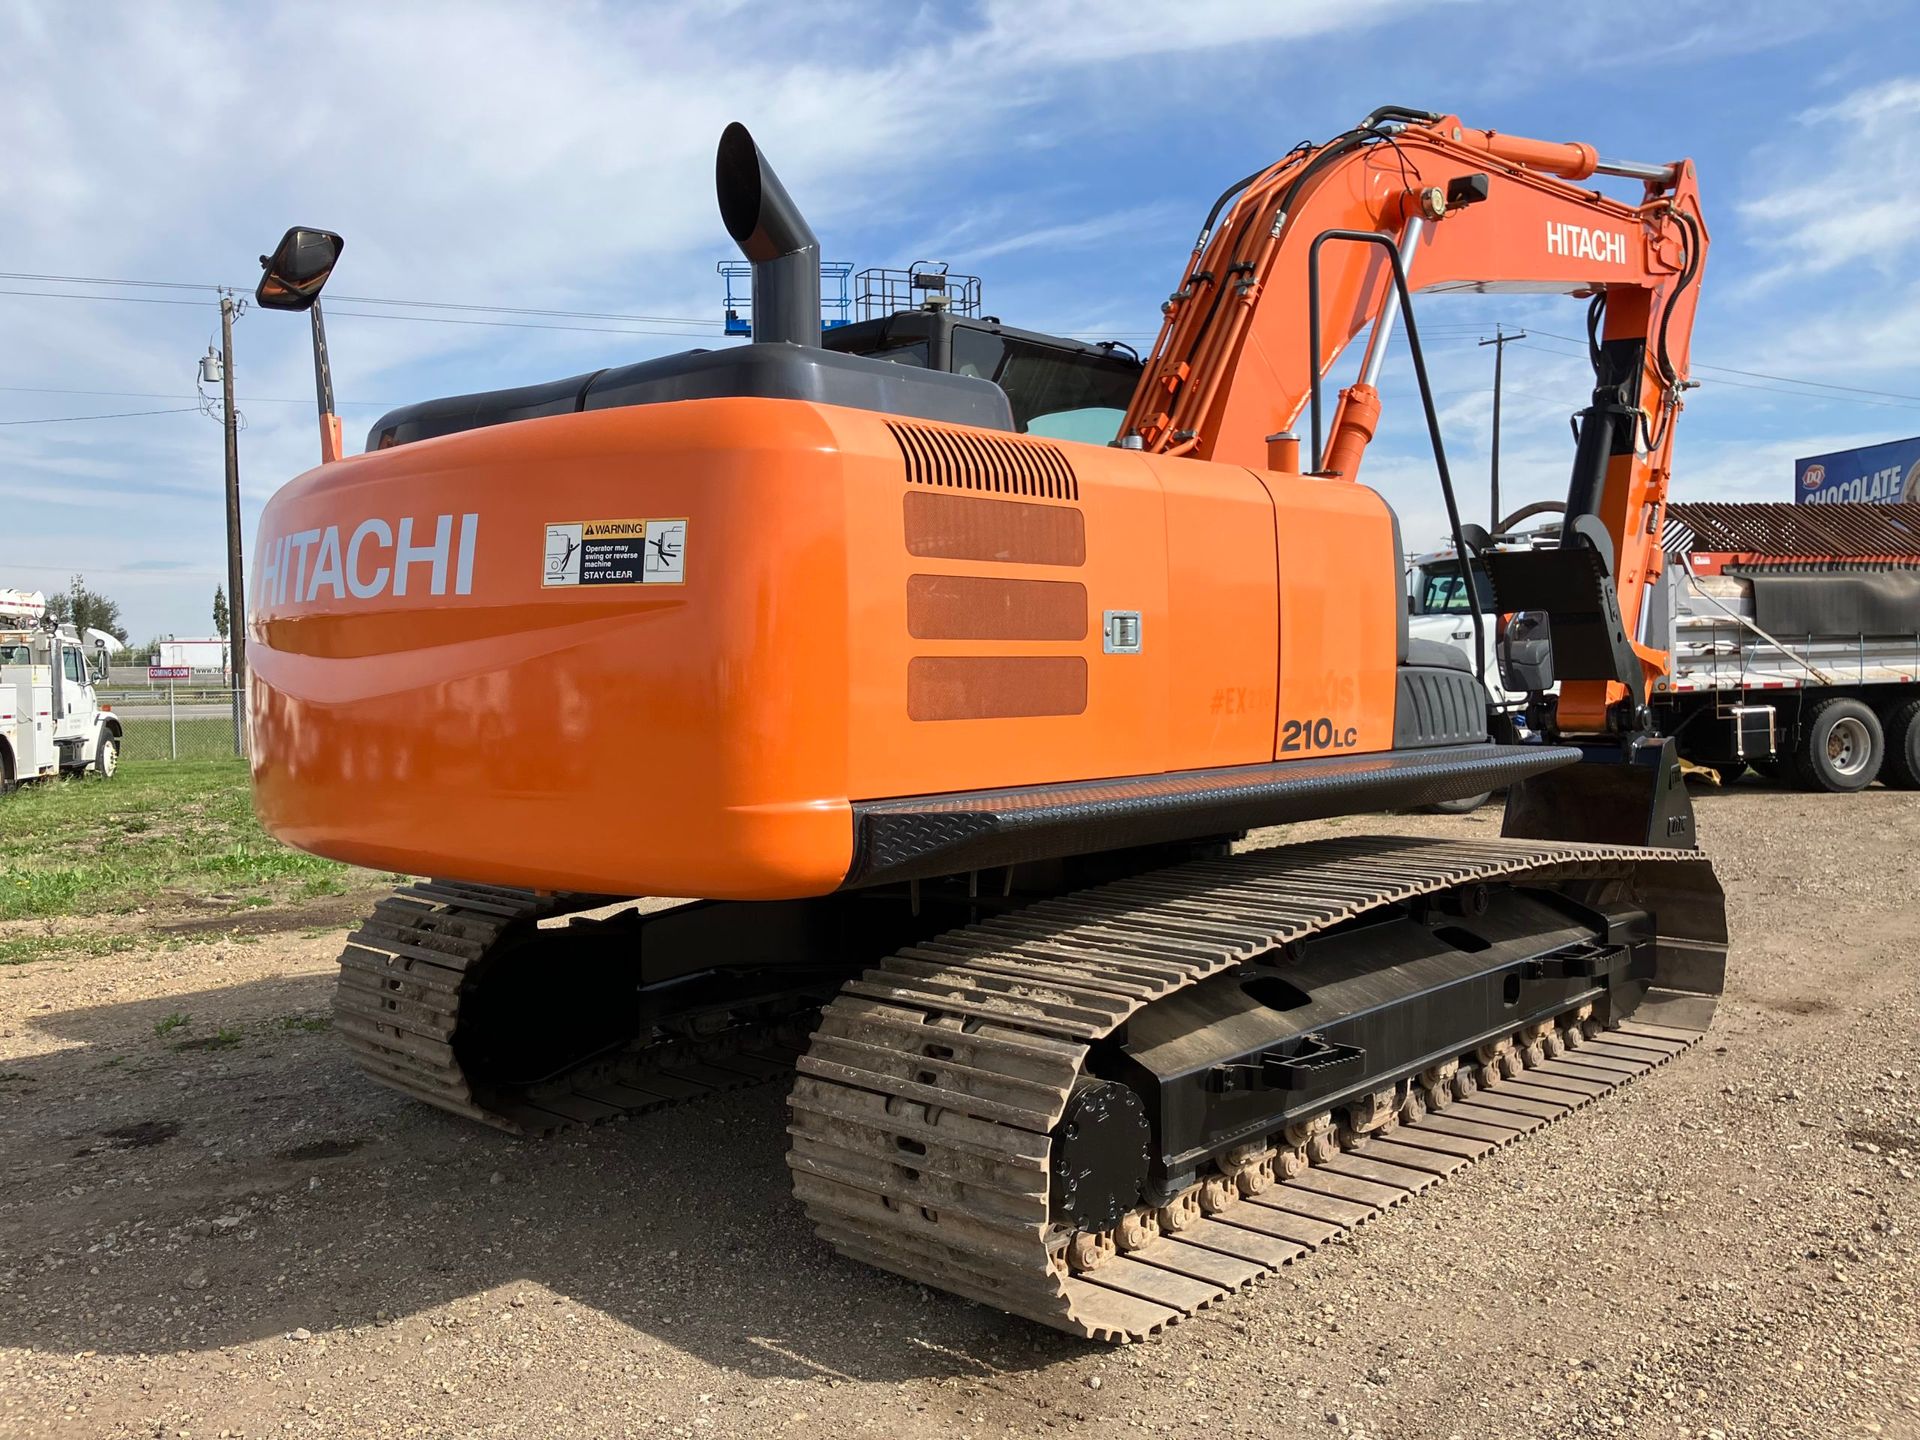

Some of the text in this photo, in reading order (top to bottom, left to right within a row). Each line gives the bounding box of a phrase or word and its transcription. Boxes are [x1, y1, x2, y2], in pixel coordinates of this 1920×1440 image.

[1546, 220, 1627, 265] HITACHI
[1807, 470, 1822, 484] DQ
[595, 523, 643, 535] WARNING
[585, 545, 613, 553] Operator
[260, 513, 479, 609] HITACHI
[585, 553, 604, 561] swing
[583, 570, 633, 579] STAY CLEAR
[150, 669, 172, 677] COMING
